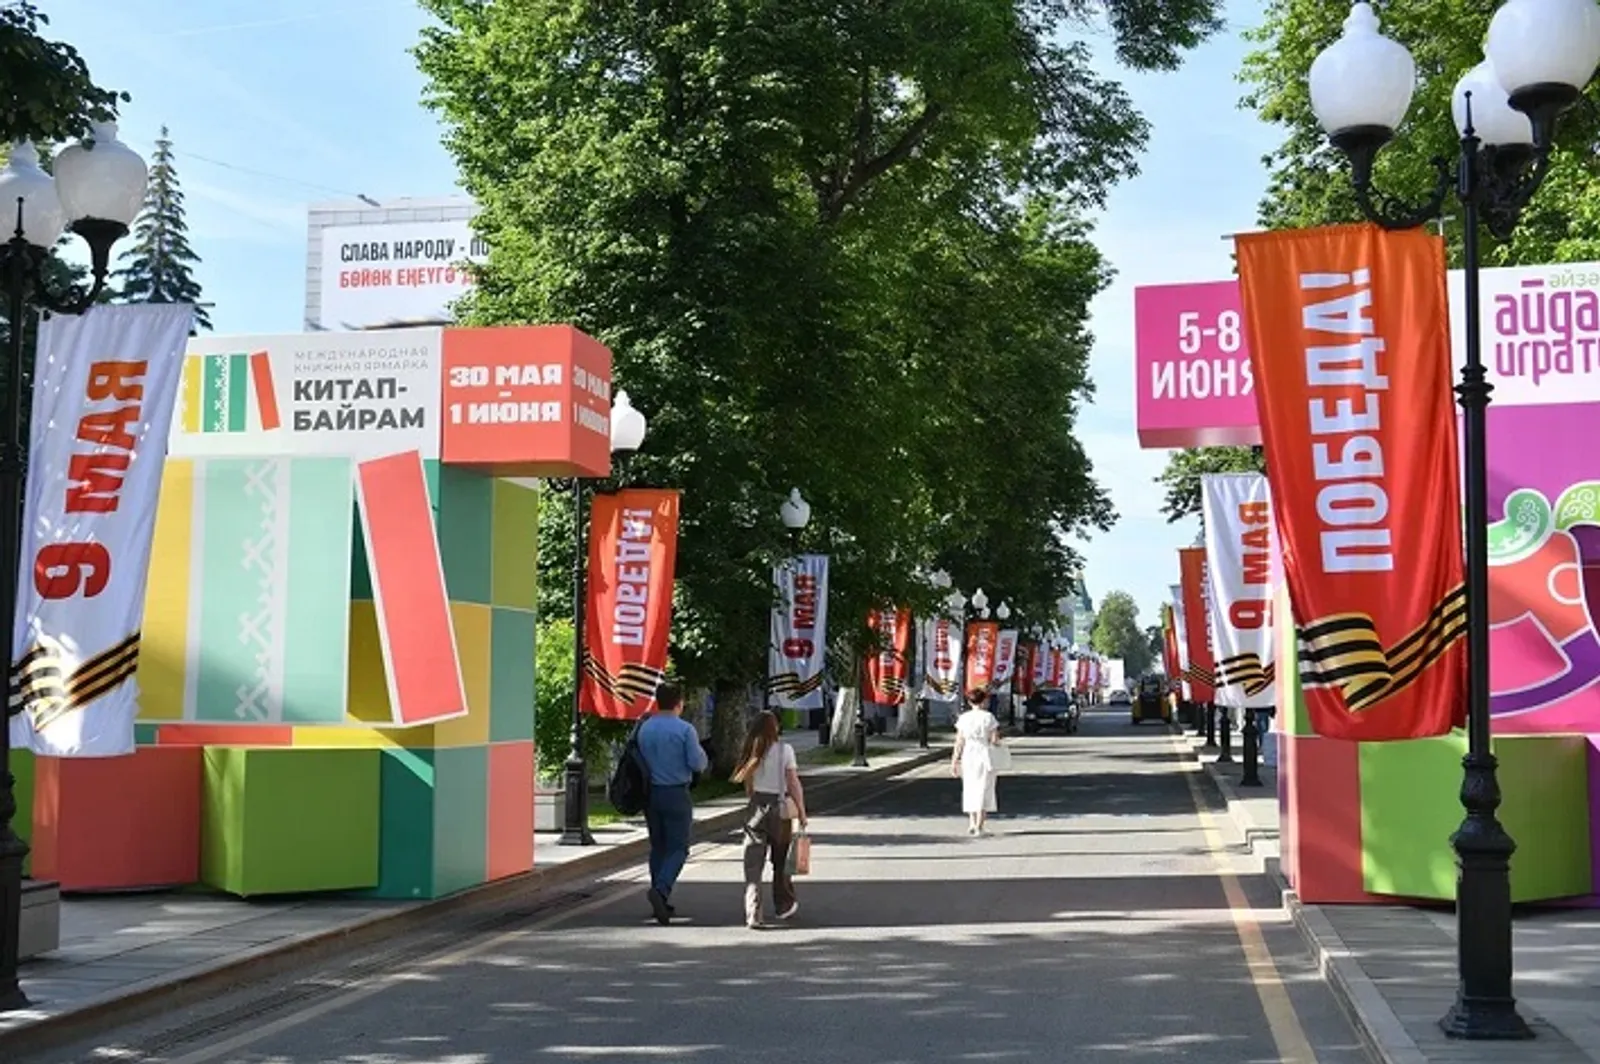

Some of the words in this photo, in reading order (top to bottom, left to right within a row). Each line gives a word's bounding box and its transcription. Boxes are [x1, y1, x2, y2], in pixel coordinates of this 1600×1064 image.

[341, 242, 389, 262] СЛАВА
[393, 238, 456, 261] НАРОДУ
[1179, 311, 1241, 354] 5-8
[294, 361, 361, 373] КНИЖНАЯ
[364, 359, 428, 371] ЯРМАРКА
[295, 347, 428, 361] МЕЖДУНАРОДНАЯ
[294, 377, 408, 401] КИТАП-
[450, 366, 489, 387] 30
[495, 363, 562, 386] МАЯ
[294, 403, 424, 431] БАЙРАМ
[450, 403, 462, 424] 1
[468, 401, 561, 424] ИЮНЯ
[1299, 267, 1394, 574] ПОБЕДА!
[64, 359, 148, 515] МАЯ
[1238, 501, 1271, 585] МАЯ
[33, 540, 112, 600] 9
[793, 573, 816, 630] МАЯ
[1229, 598, 1274, 630] 9
[783, 637, 815, 660] 9
